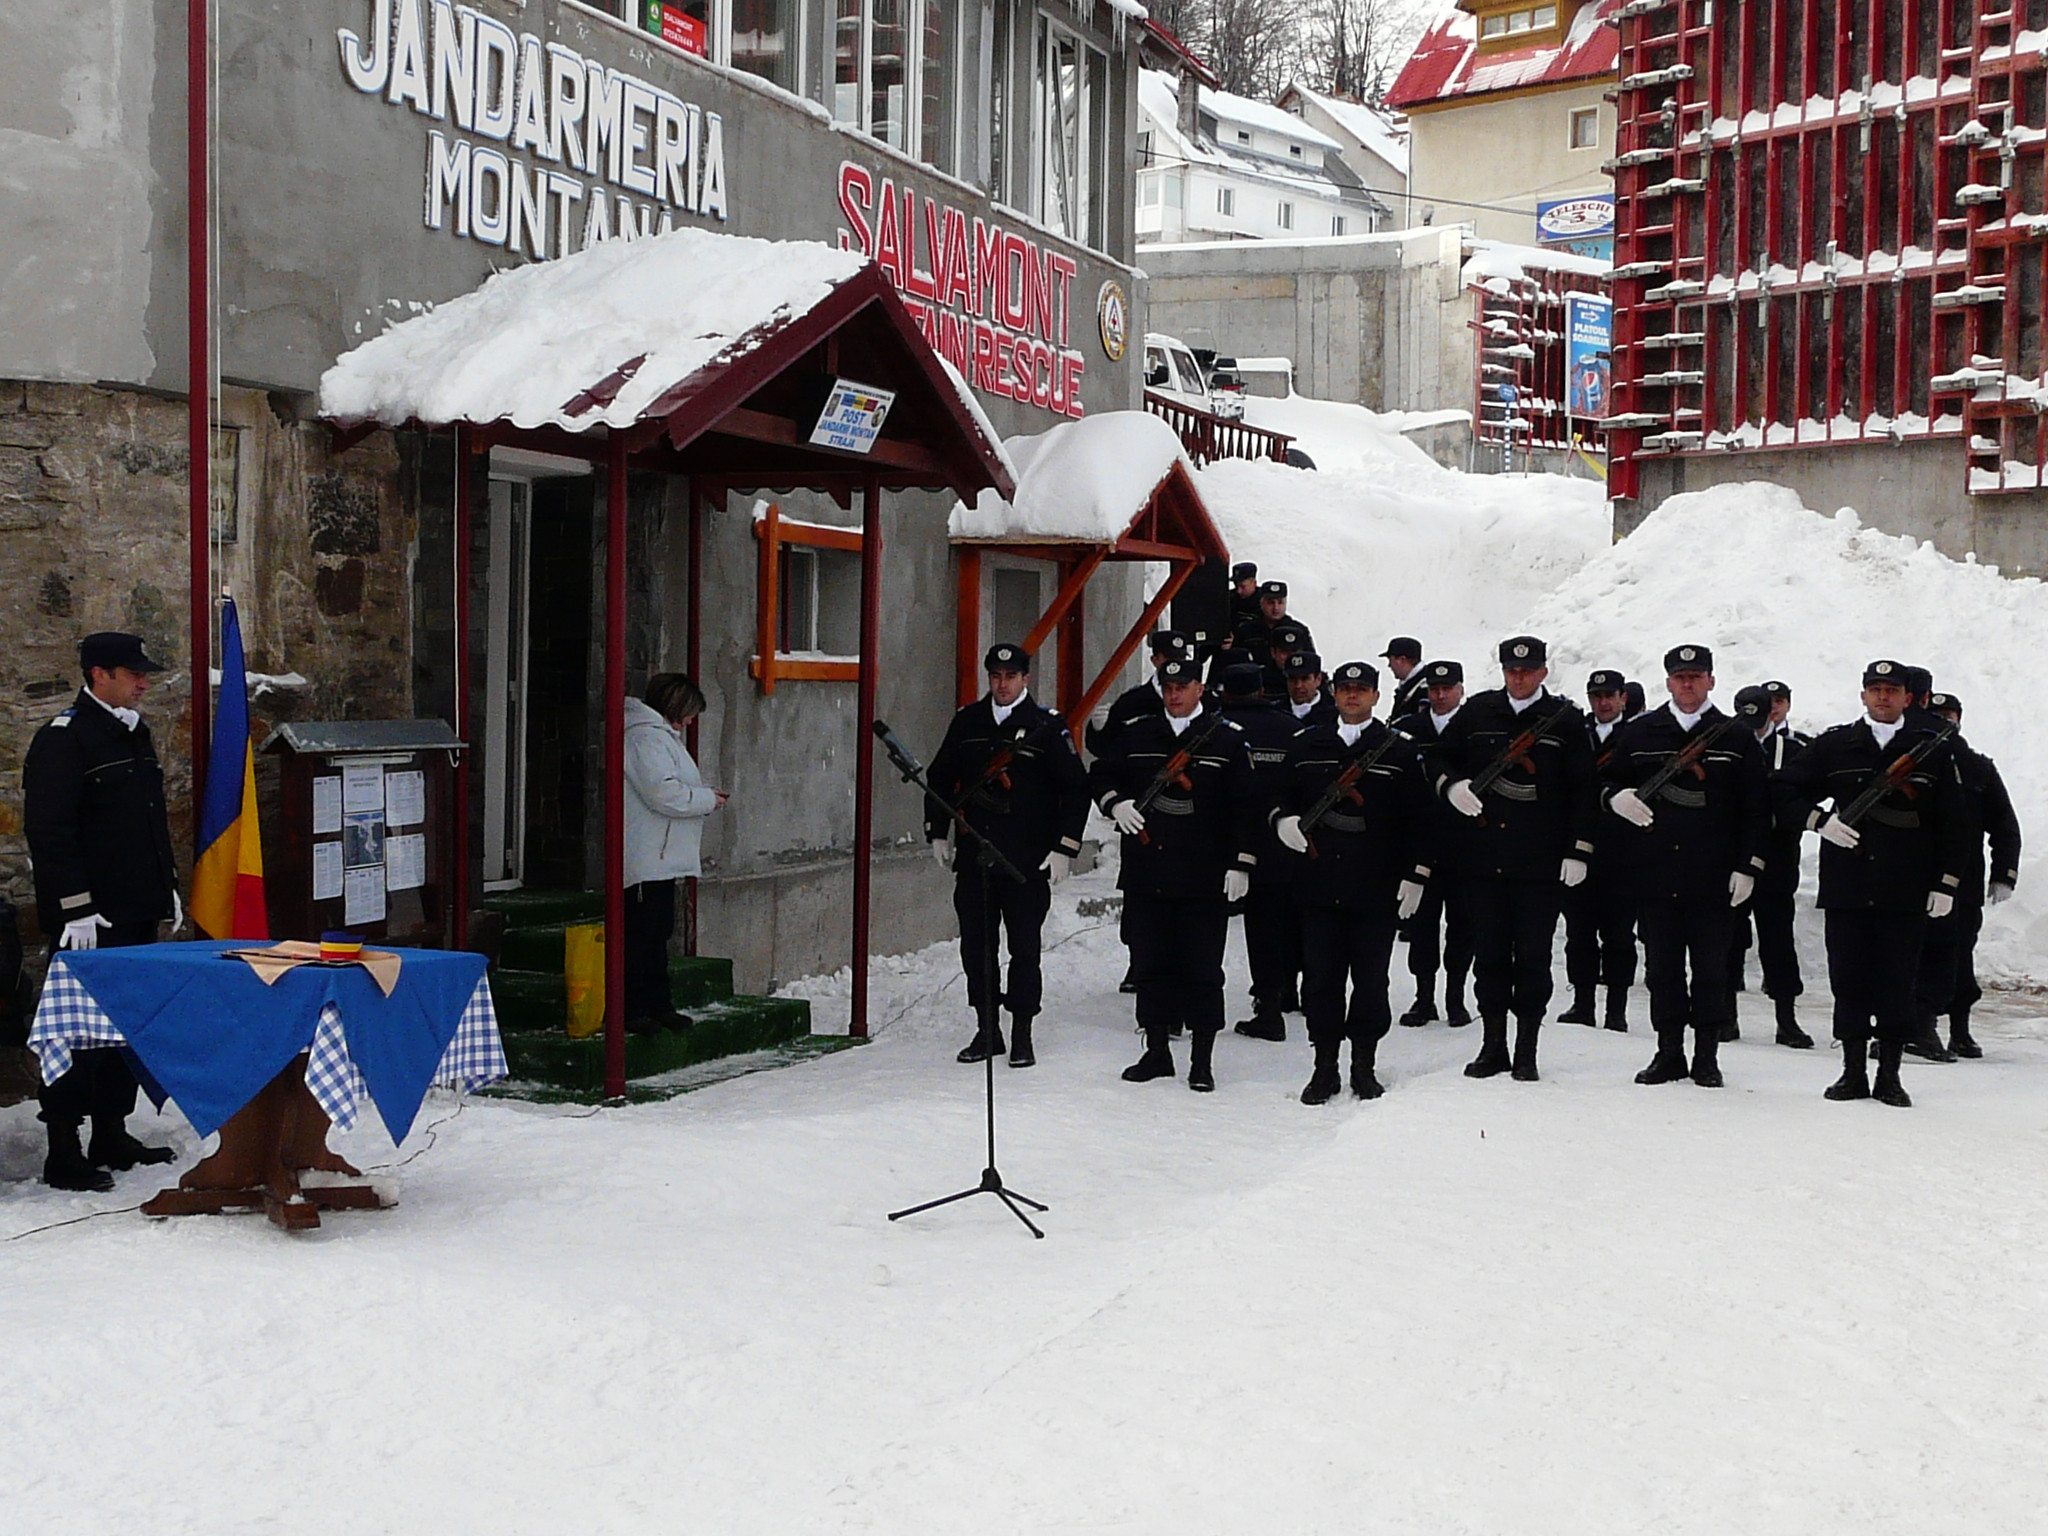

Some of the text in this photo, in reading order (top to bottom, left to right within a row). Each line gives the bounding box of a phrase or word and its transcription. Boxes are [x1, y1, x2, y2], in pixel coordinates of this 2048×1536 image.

[338, 0, 729, 221] JANDARMERIA
[1547, 203, 1611, 219] TELESCHI
[1570, 211, 1586, 224] 3
[838, 159, 1077, 347] SALVAMONT
[1574, 322, 1609, 336] PLATOUL
[972, 319, 1084, 419] RESCUE
[840, 409, 867, 425] POST
[828, 435, 856, 448] STRAJA
